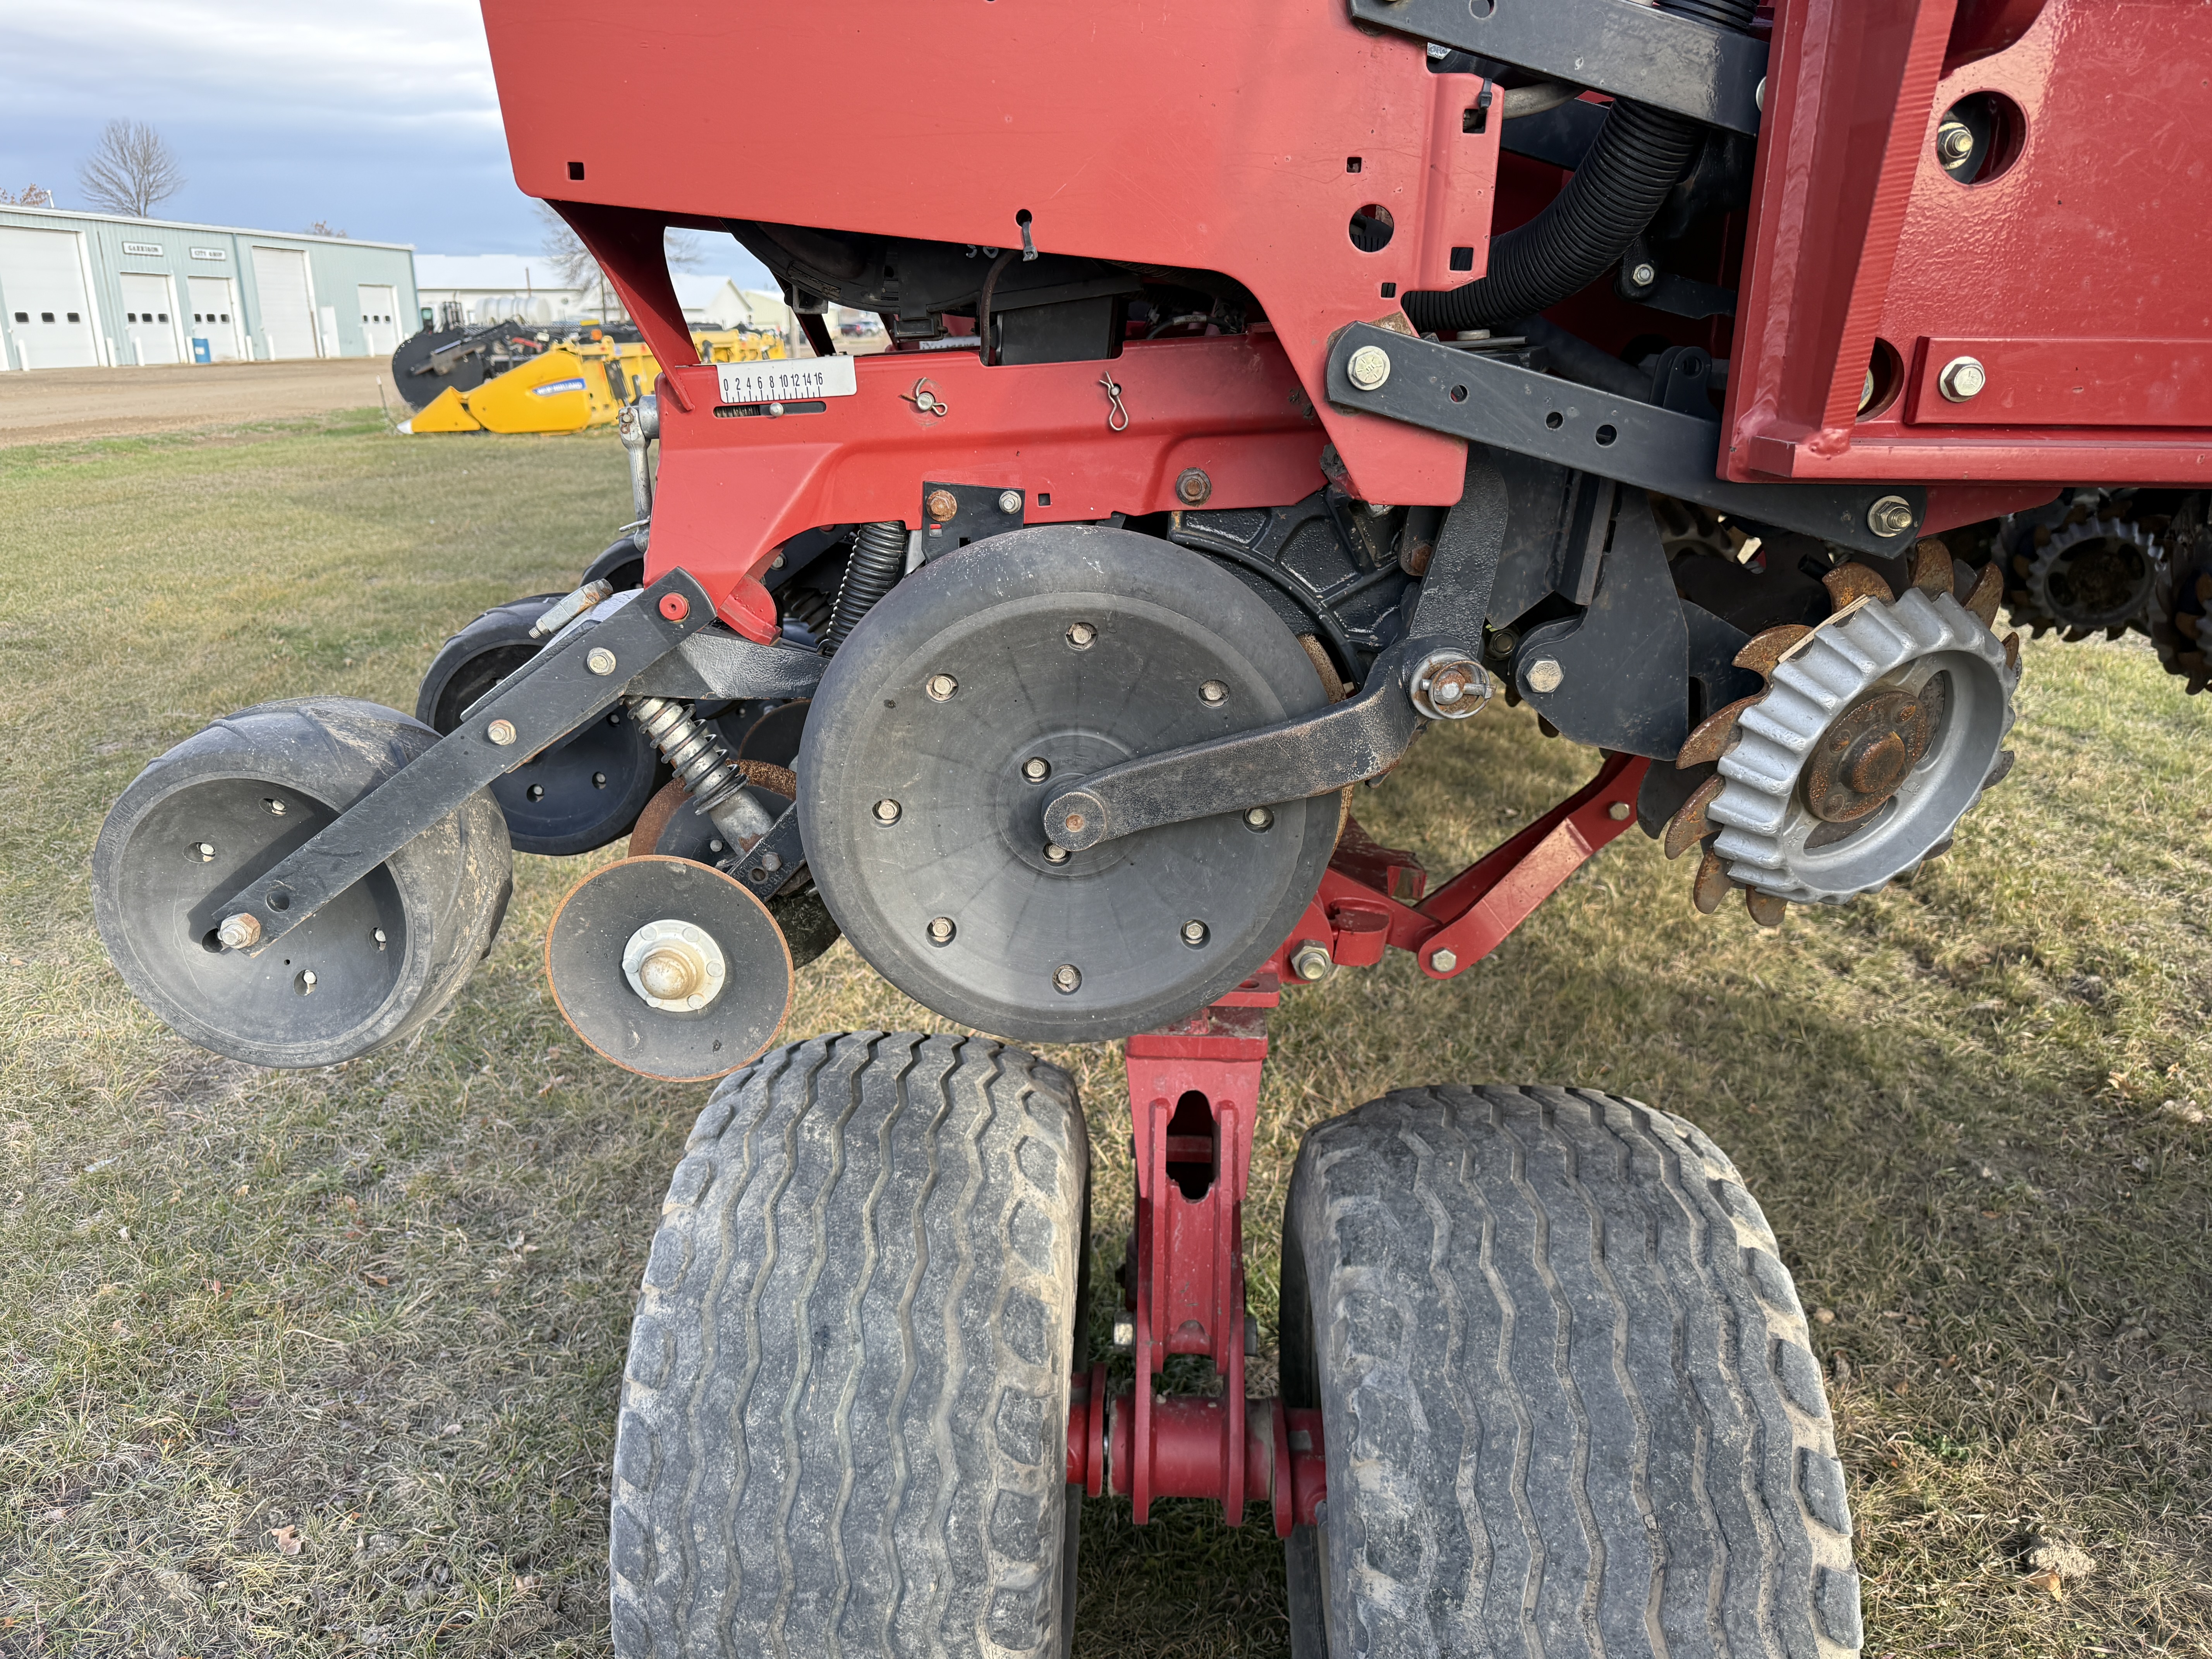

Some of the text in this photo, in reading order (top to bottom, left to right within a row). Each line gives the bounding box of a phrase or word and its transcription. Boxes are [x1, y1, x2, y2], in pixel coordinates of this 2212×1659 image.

[723, 372, 823, 392] 0 2 4 6 8 10 12 14 16
